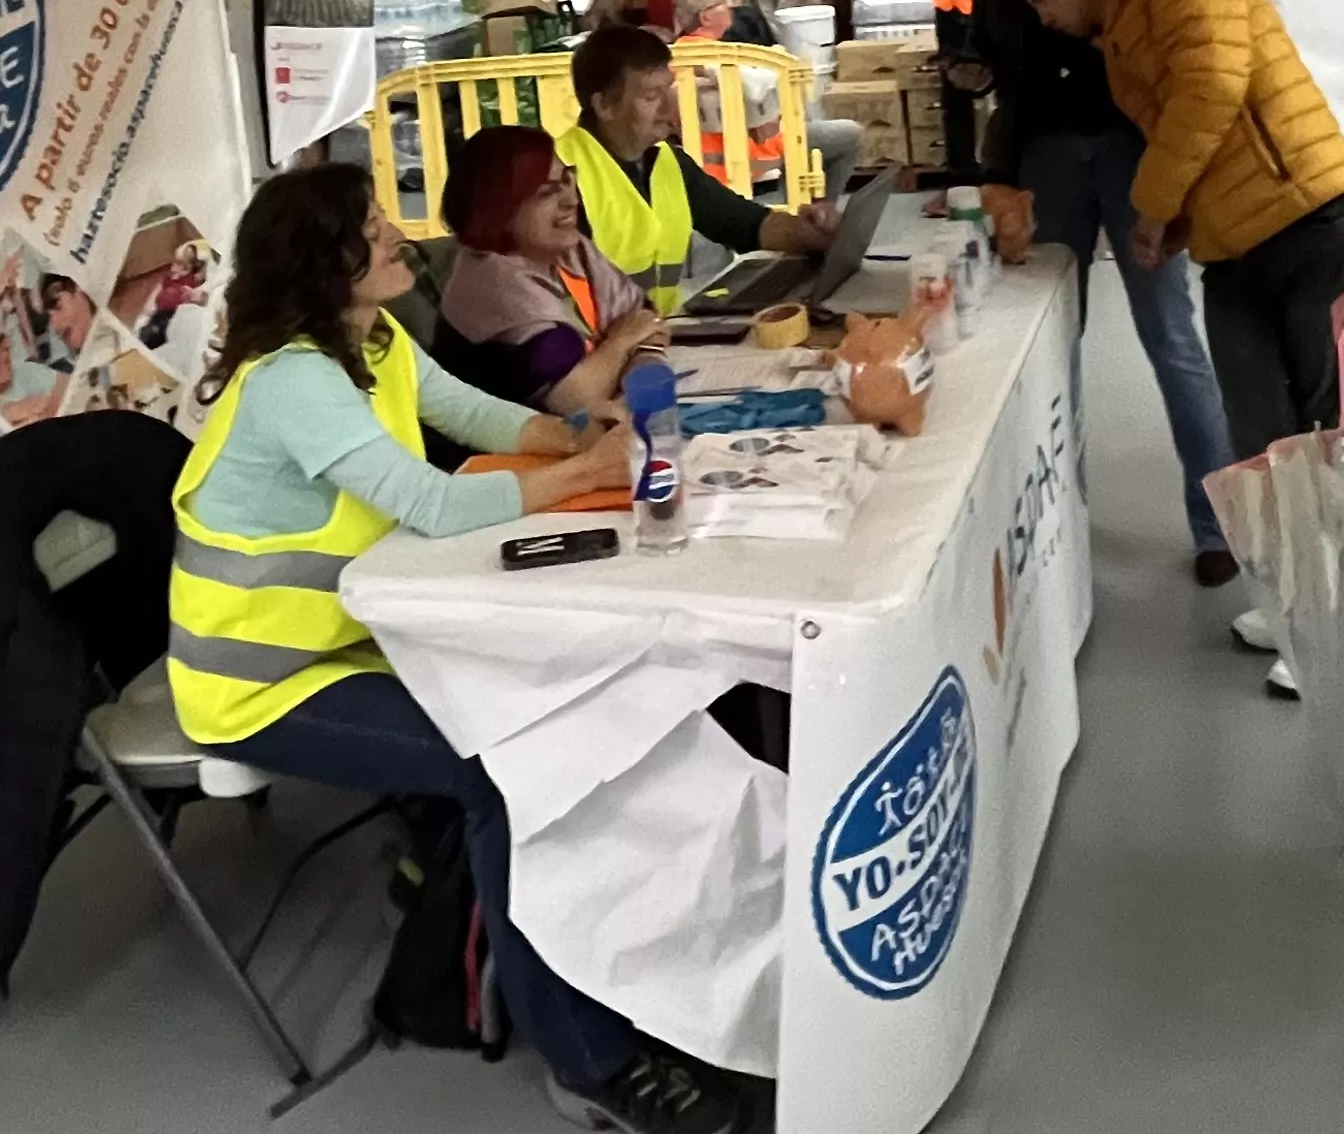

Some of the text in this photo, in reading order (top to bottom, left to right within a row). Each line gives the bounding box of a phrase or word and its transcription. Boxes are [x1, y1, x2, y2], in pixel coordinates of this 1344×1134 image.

[20, 193, 43, 220] A
[34, 94, 81, 191] partir
[72, 52, 102, 92] de
[90, 7, 119, 50] 30
